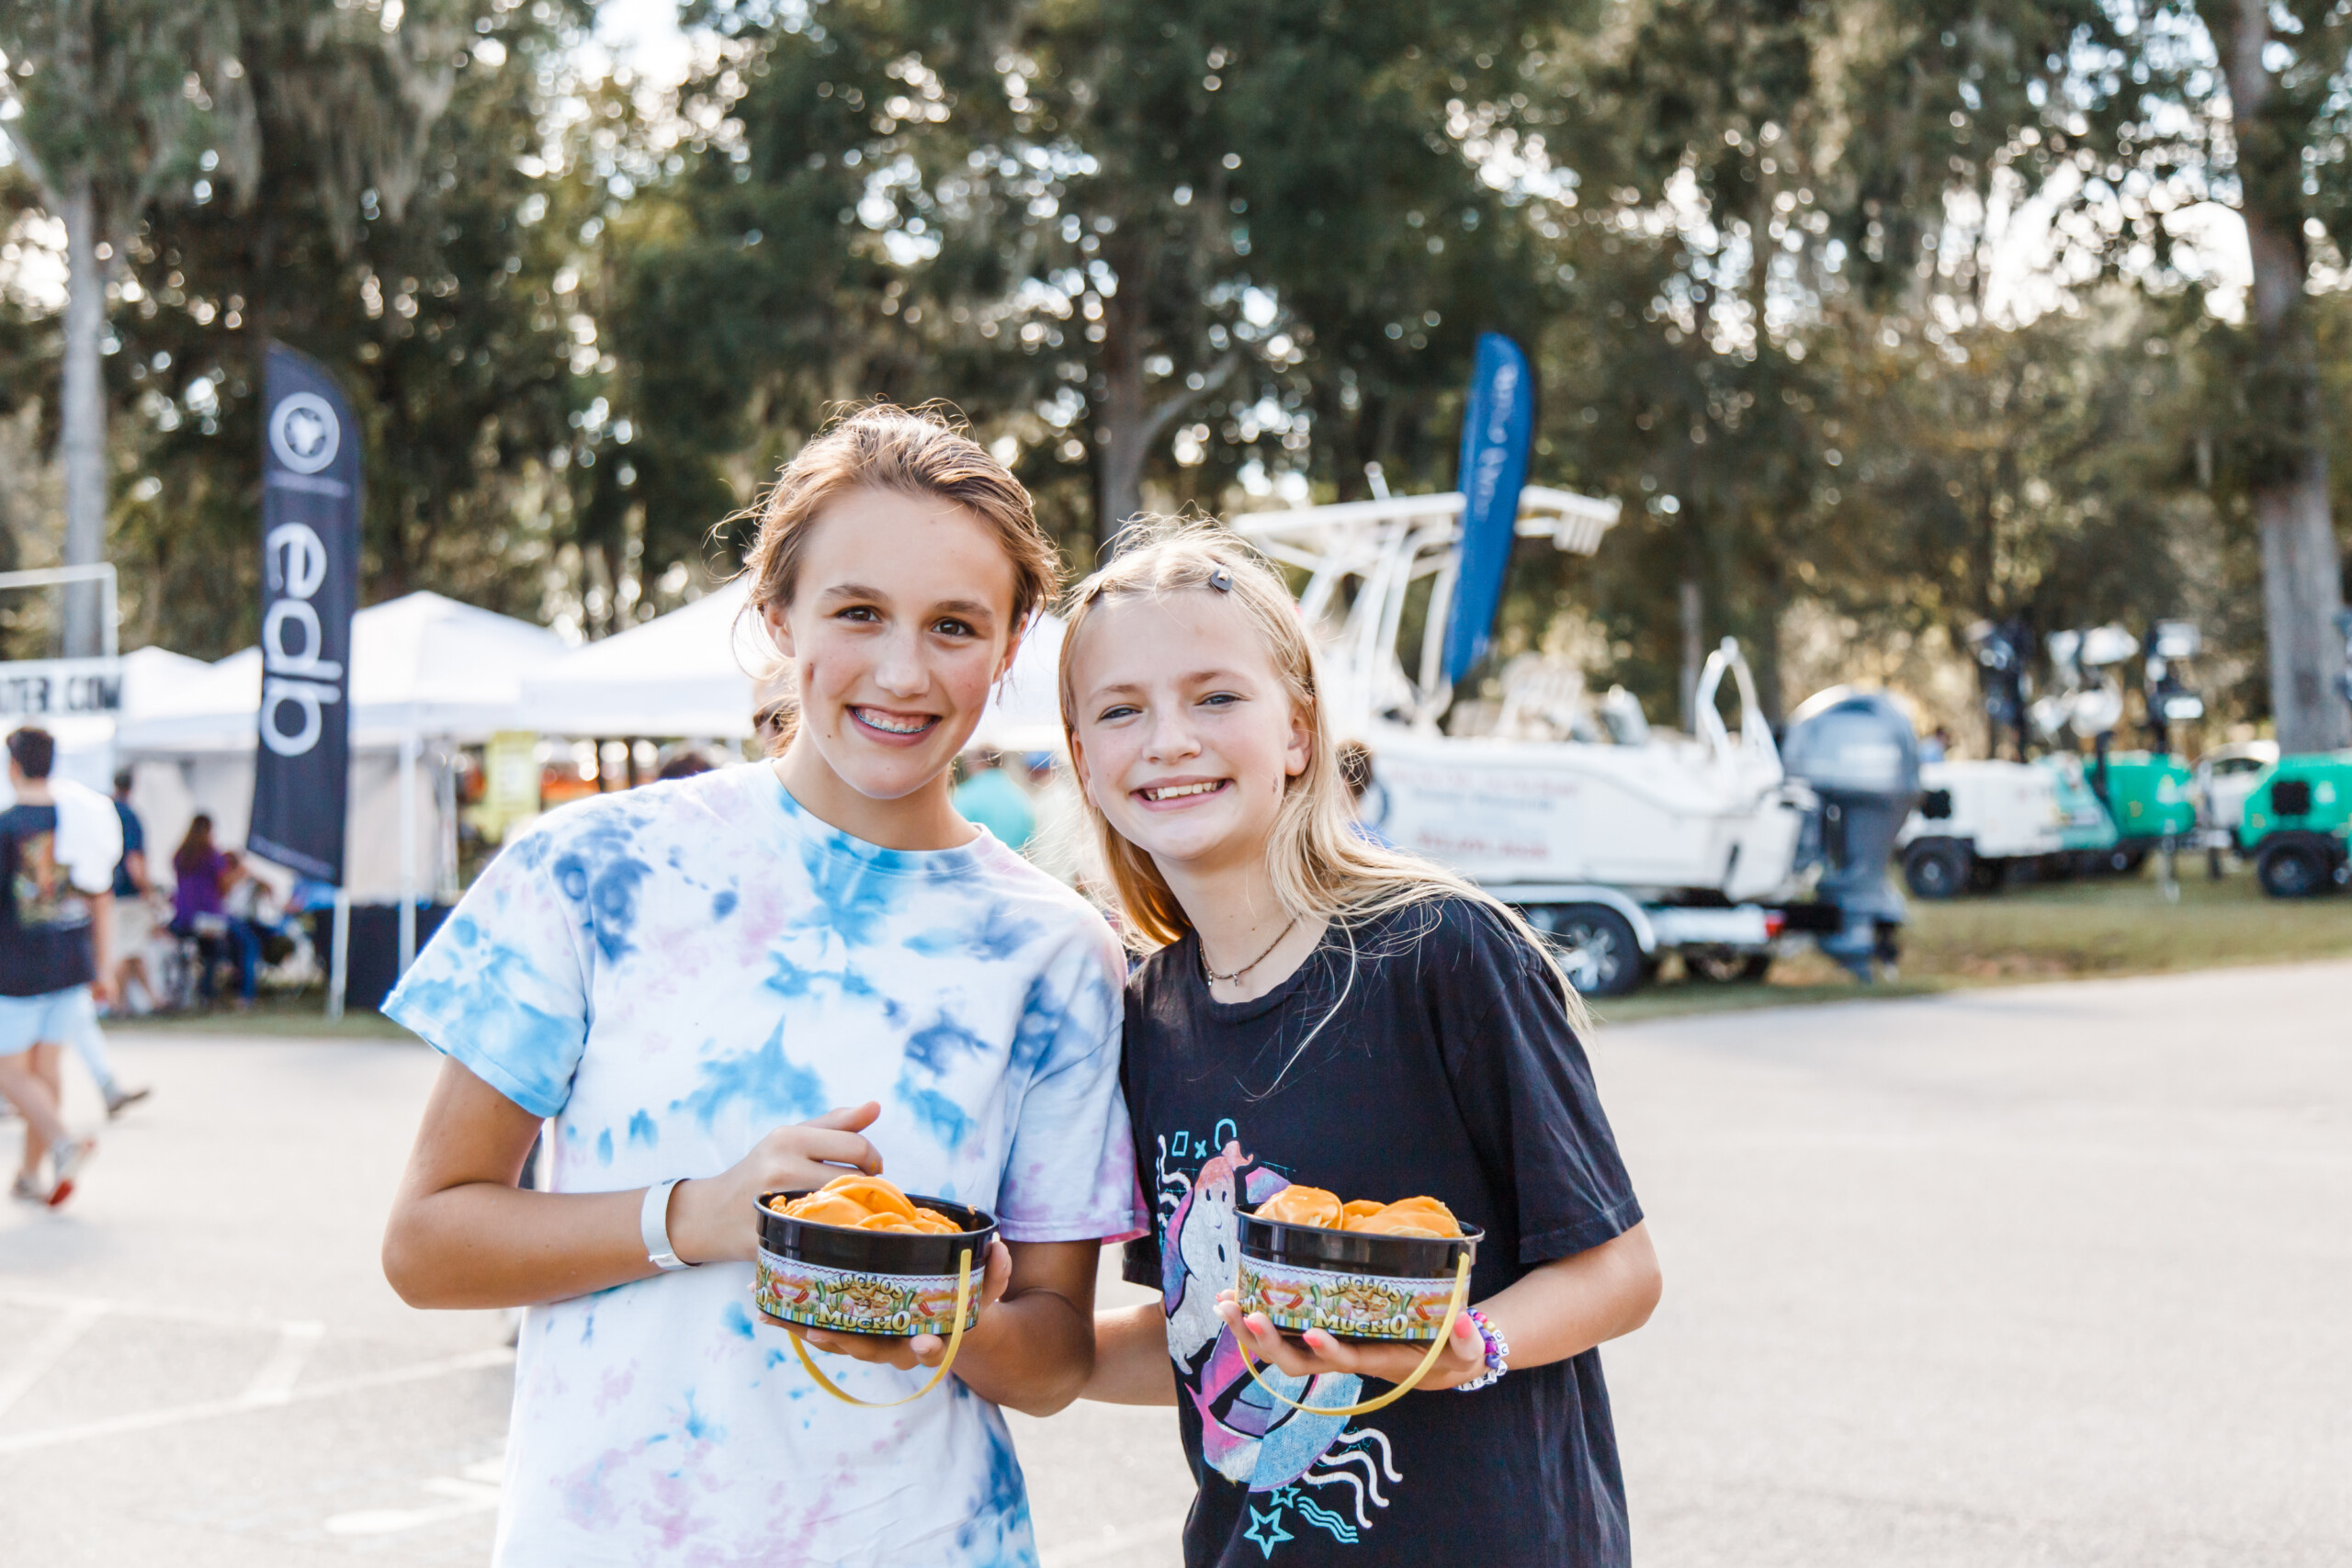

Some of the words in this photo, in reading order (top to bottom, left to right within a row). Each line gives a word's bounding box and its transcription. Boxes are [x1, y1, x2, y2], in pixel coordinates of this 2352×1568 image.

[260, 522, 343, 757] edb
[829, 1272, 909, 1300] NACHOS
[1325, 1275, 1404, 1303] NACHOS
[817, 1303, 912, 1331] MUCHO
[1314, 1305, 1410, 1335] MUCHO
